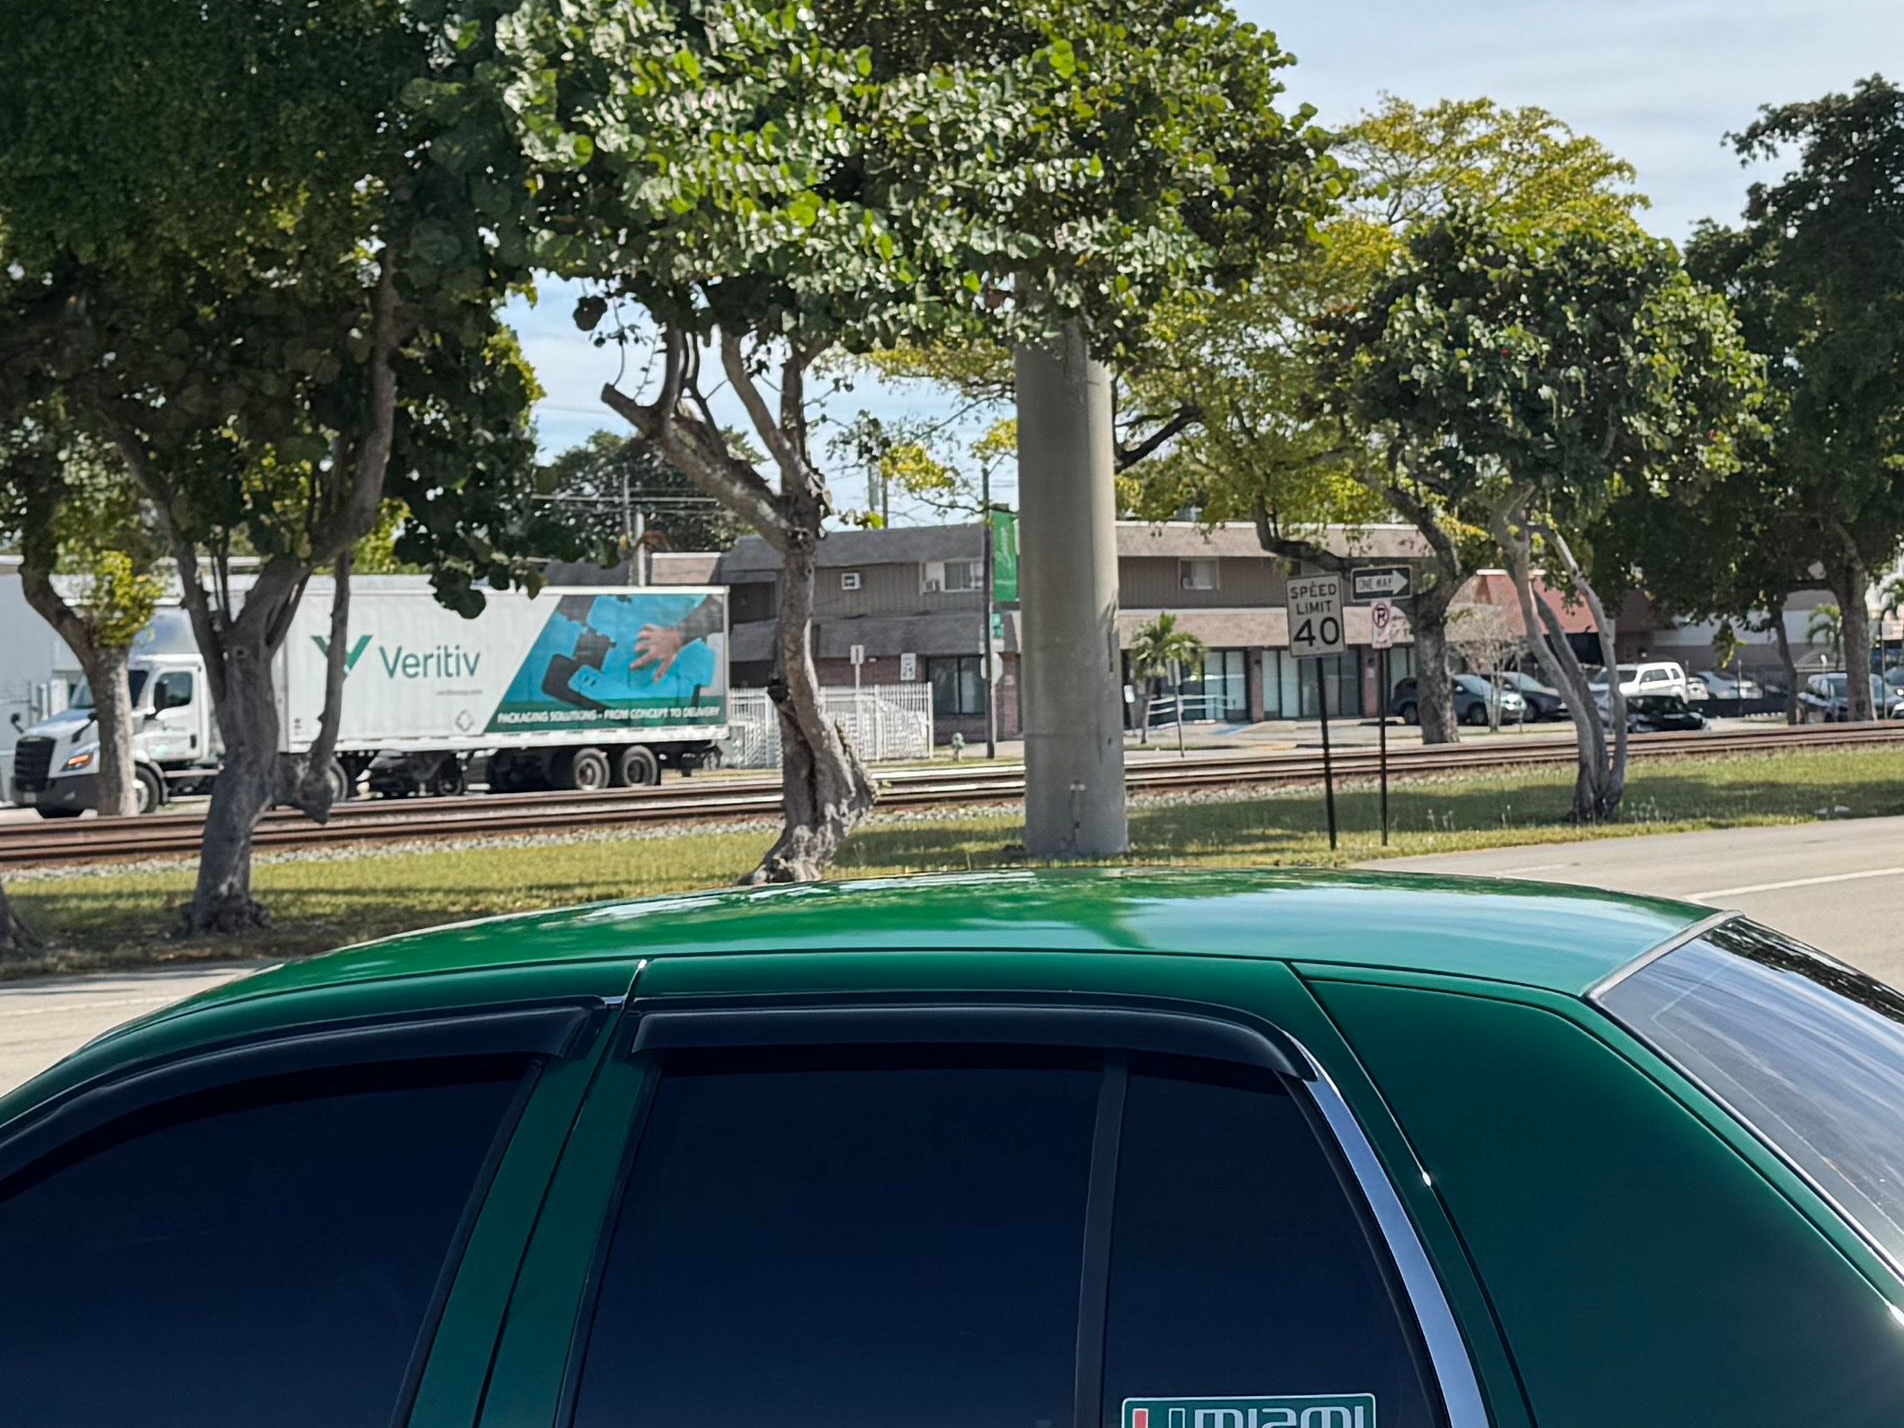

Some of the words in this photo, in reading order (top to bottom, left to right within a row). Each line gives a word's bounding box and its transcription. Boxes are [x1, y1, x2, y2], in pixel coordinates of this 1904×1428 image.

[1290, 582, 1337, 600] SPEED
[1296, 600, 1332, 615] LIMIT
[1293, 616, 1341, 647] 40
[378, 644, 481, 679] Veritiv
[670, 707, 682, 718] TO
